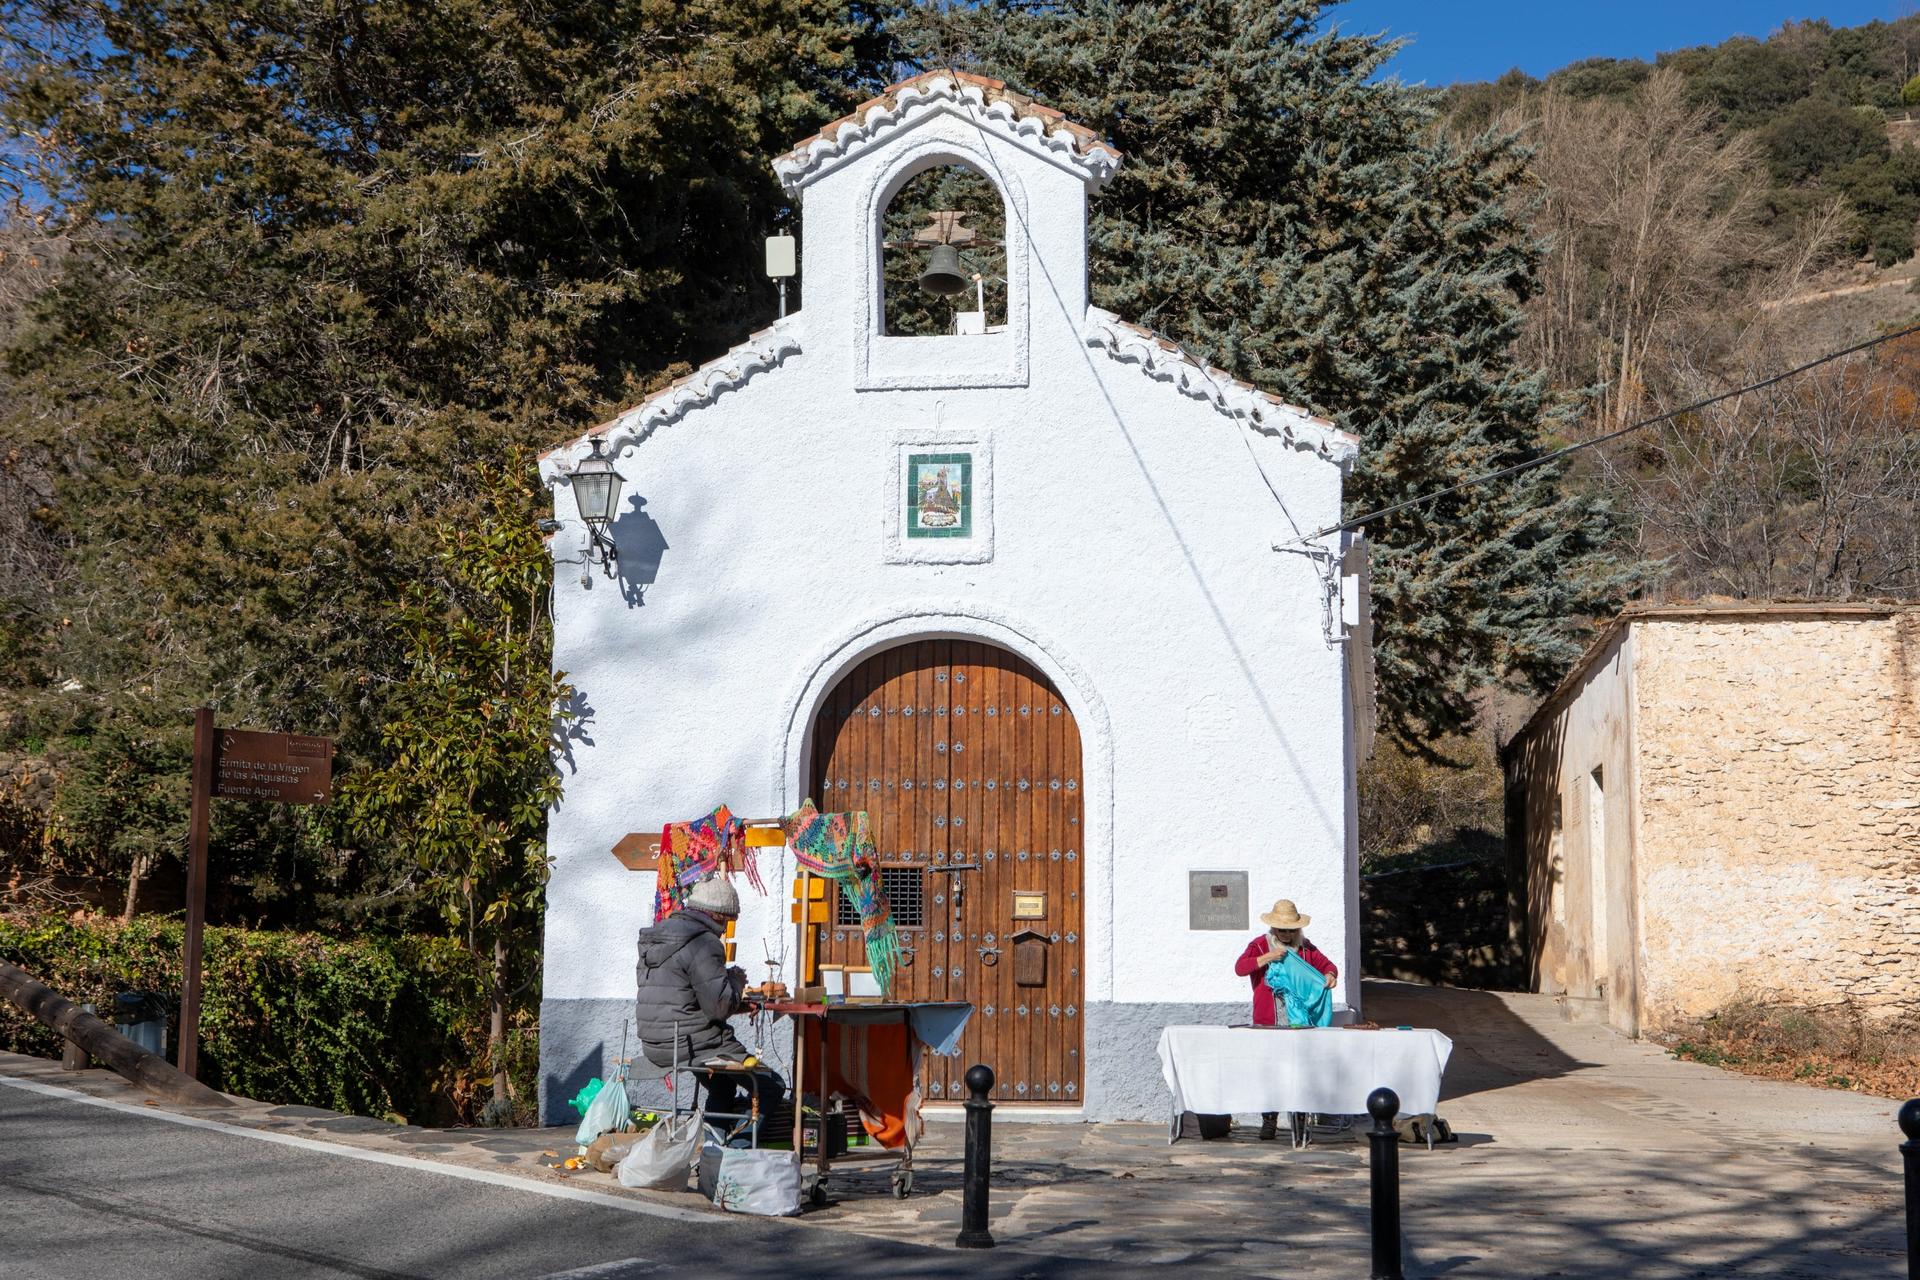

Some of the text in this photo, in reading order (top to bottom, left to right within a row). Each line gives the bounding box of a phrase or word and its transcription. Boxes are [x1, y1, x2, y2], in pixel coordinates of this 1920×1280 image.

[219, 757, 310, 775] Ermita de la Virgen
[218, 769, 299, 784] de las Angustias
[218, 783, 280, 798] Fuente Agria
